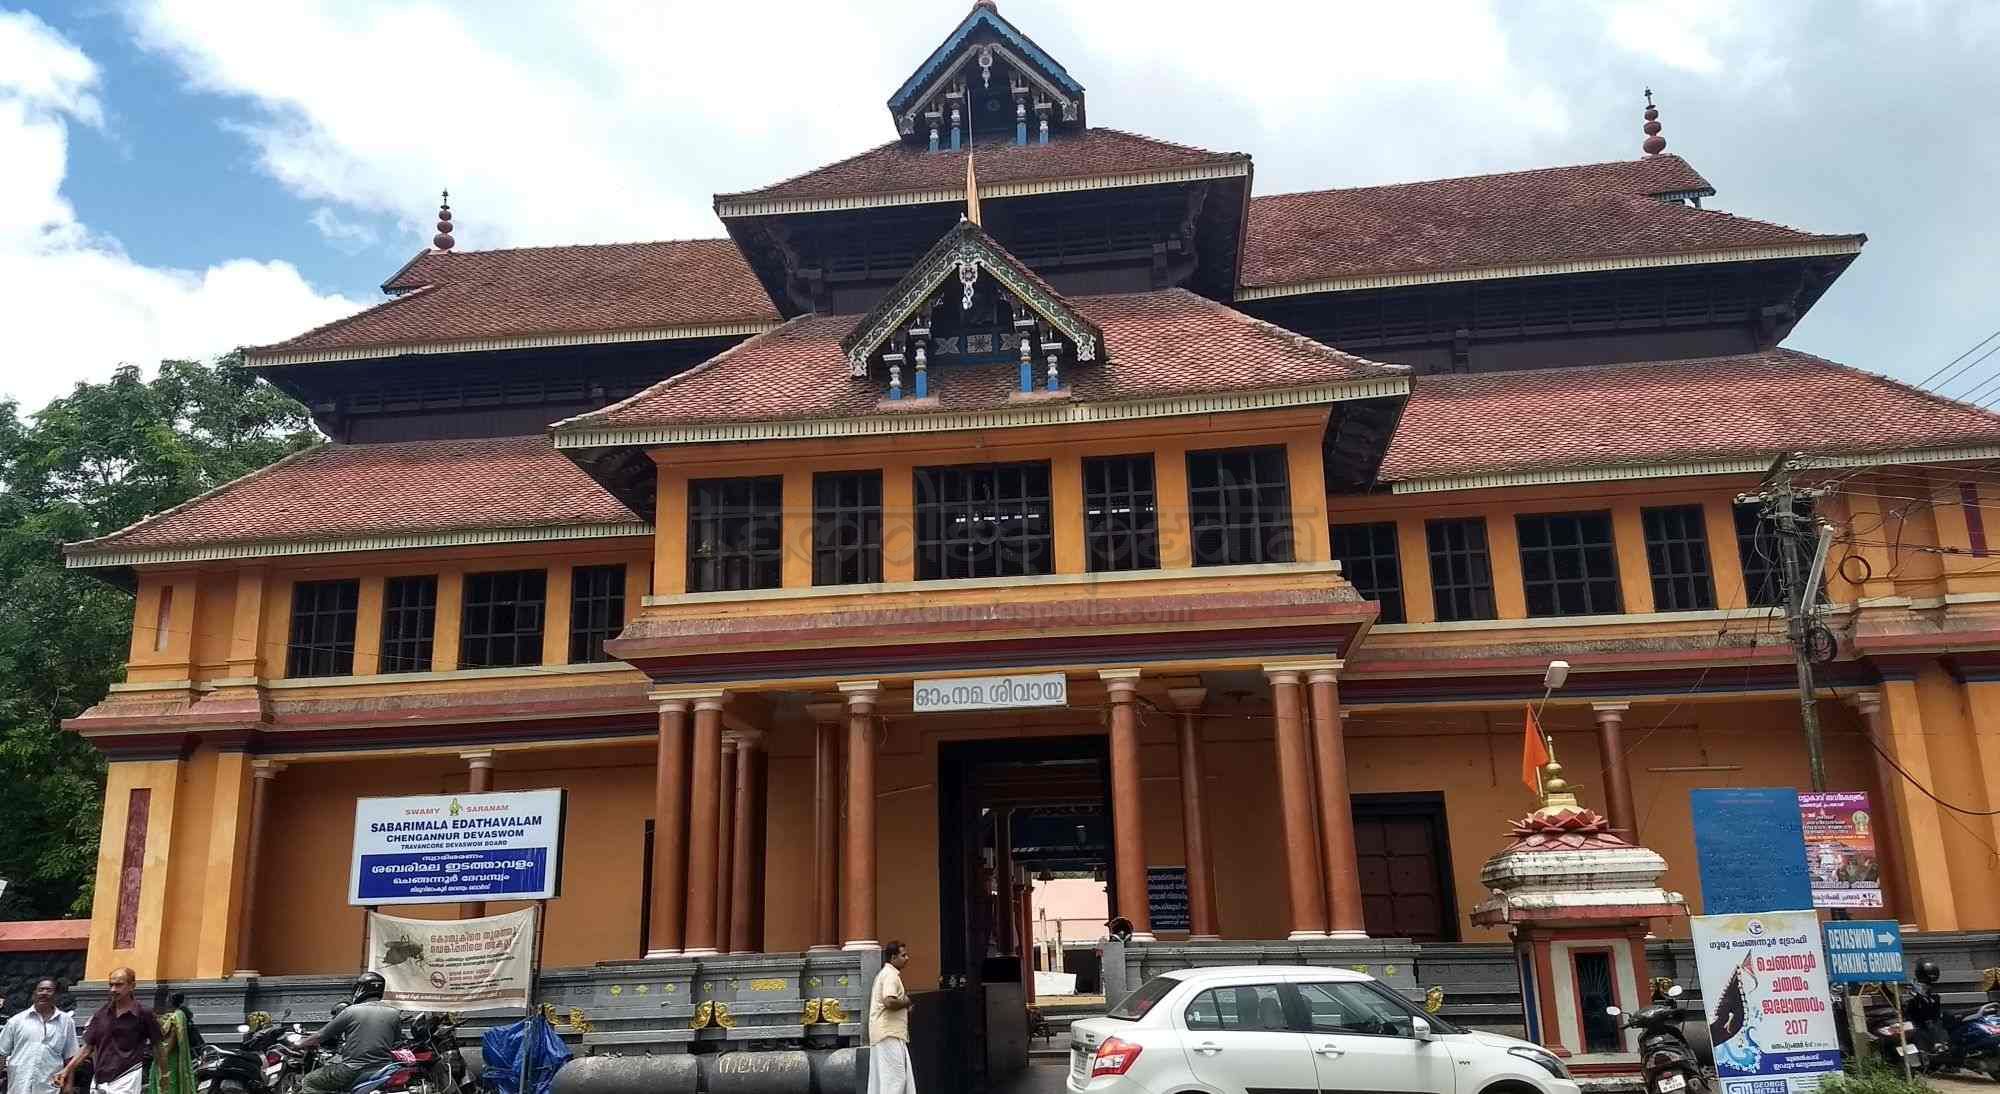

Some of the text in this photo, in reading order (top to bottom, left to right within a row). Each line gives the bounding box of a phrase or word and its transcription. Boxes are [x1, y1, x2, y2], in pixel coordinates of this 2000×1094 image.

[404, 804, 509, 816] SWAMY SARANAM
[371, 815, 542, 833] SABARIMALA EDATHAVALAM
[386, 829, 524, 843] CHENGANNUR DEVASWOM
[371, 859, 534, 874] ശബരിമല ഇടത്താവളം
[1828, 928, 1877, 950] DEVASWOM
[1756, 951, 1817, 973] ചെങ്ങന്നൂർ
[1831, 951, 1904, 975] PARKING GROUND
[1771, 976, 1809, 993] ചതയം
[1762, 997, 1825, 1015] ജലോത്സവം
[1784, 1019, 1809, 1036] 2017
[1754, 1080, 1785, 1089] GEORGE
